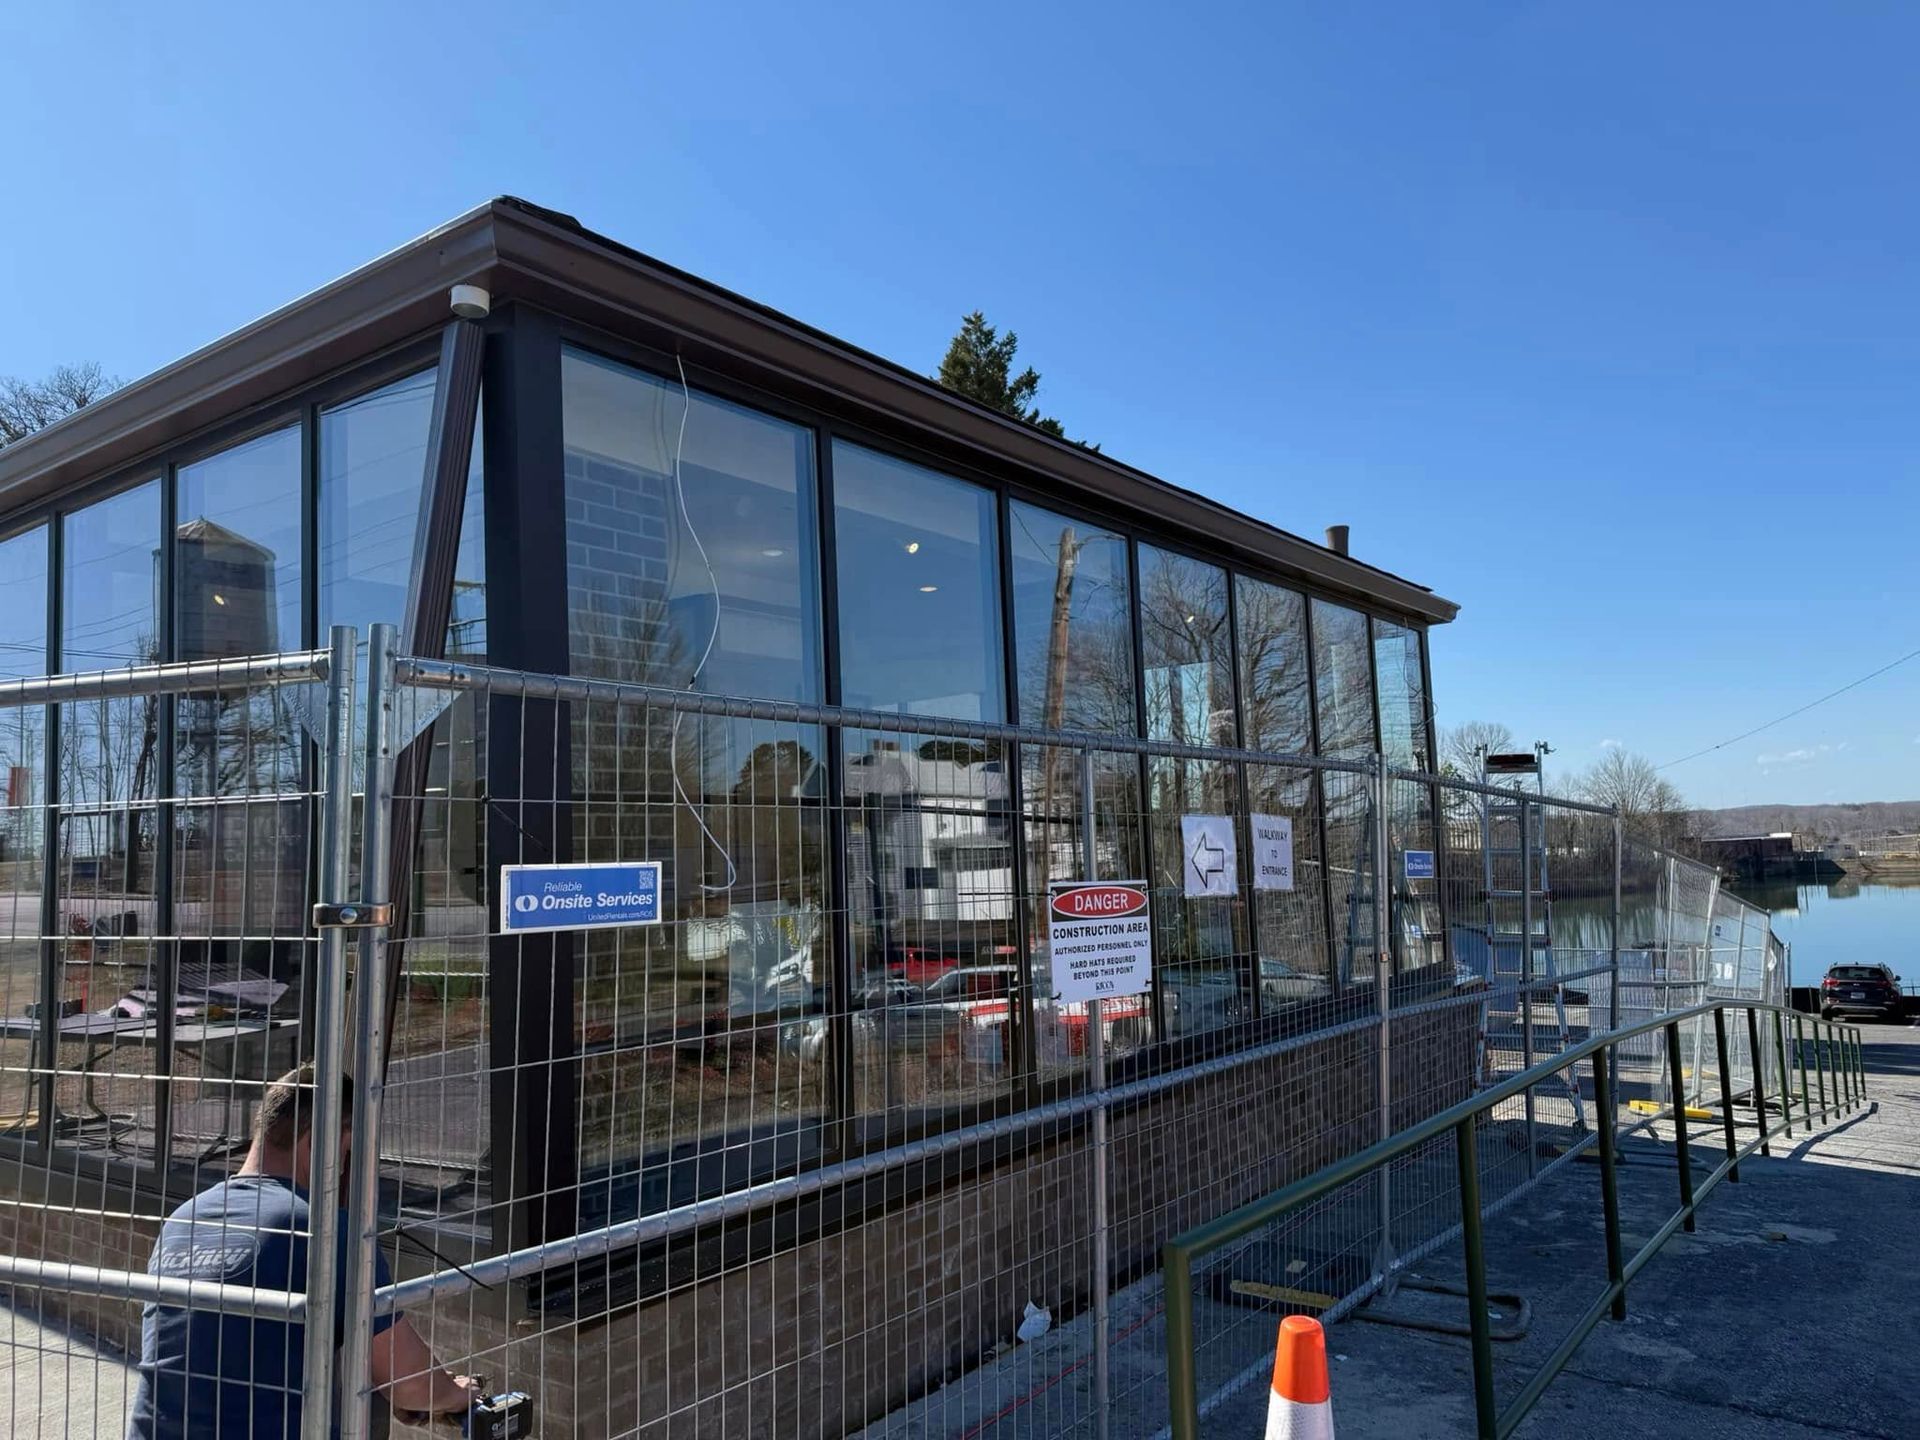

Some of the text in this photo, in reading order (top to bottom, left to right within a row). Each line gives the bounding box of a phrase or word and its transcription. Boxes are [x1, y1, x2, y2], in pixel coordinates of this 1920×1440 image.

[1258, 828, 1288, 841] WALKWAY
[1271, 849, 1278, 859] TO
[1262, 865, 1288, 877] ENTRANCE
[544, 880, 583, 893] Reliable
[542, 894, 593, 910] Onsite
[1074, 893, 1129, 912] DANGER
[1053, 922, 1149, 940] CONSTRUCTION AREA
[1054, 940, 1148, 956] AUTHORIZED PERSONNEL ONLY
[1070, 955, 1136, 970] HARD HATS REQUIRED
[1073, 965, 1134, 980] BEYOND THIS POINT
